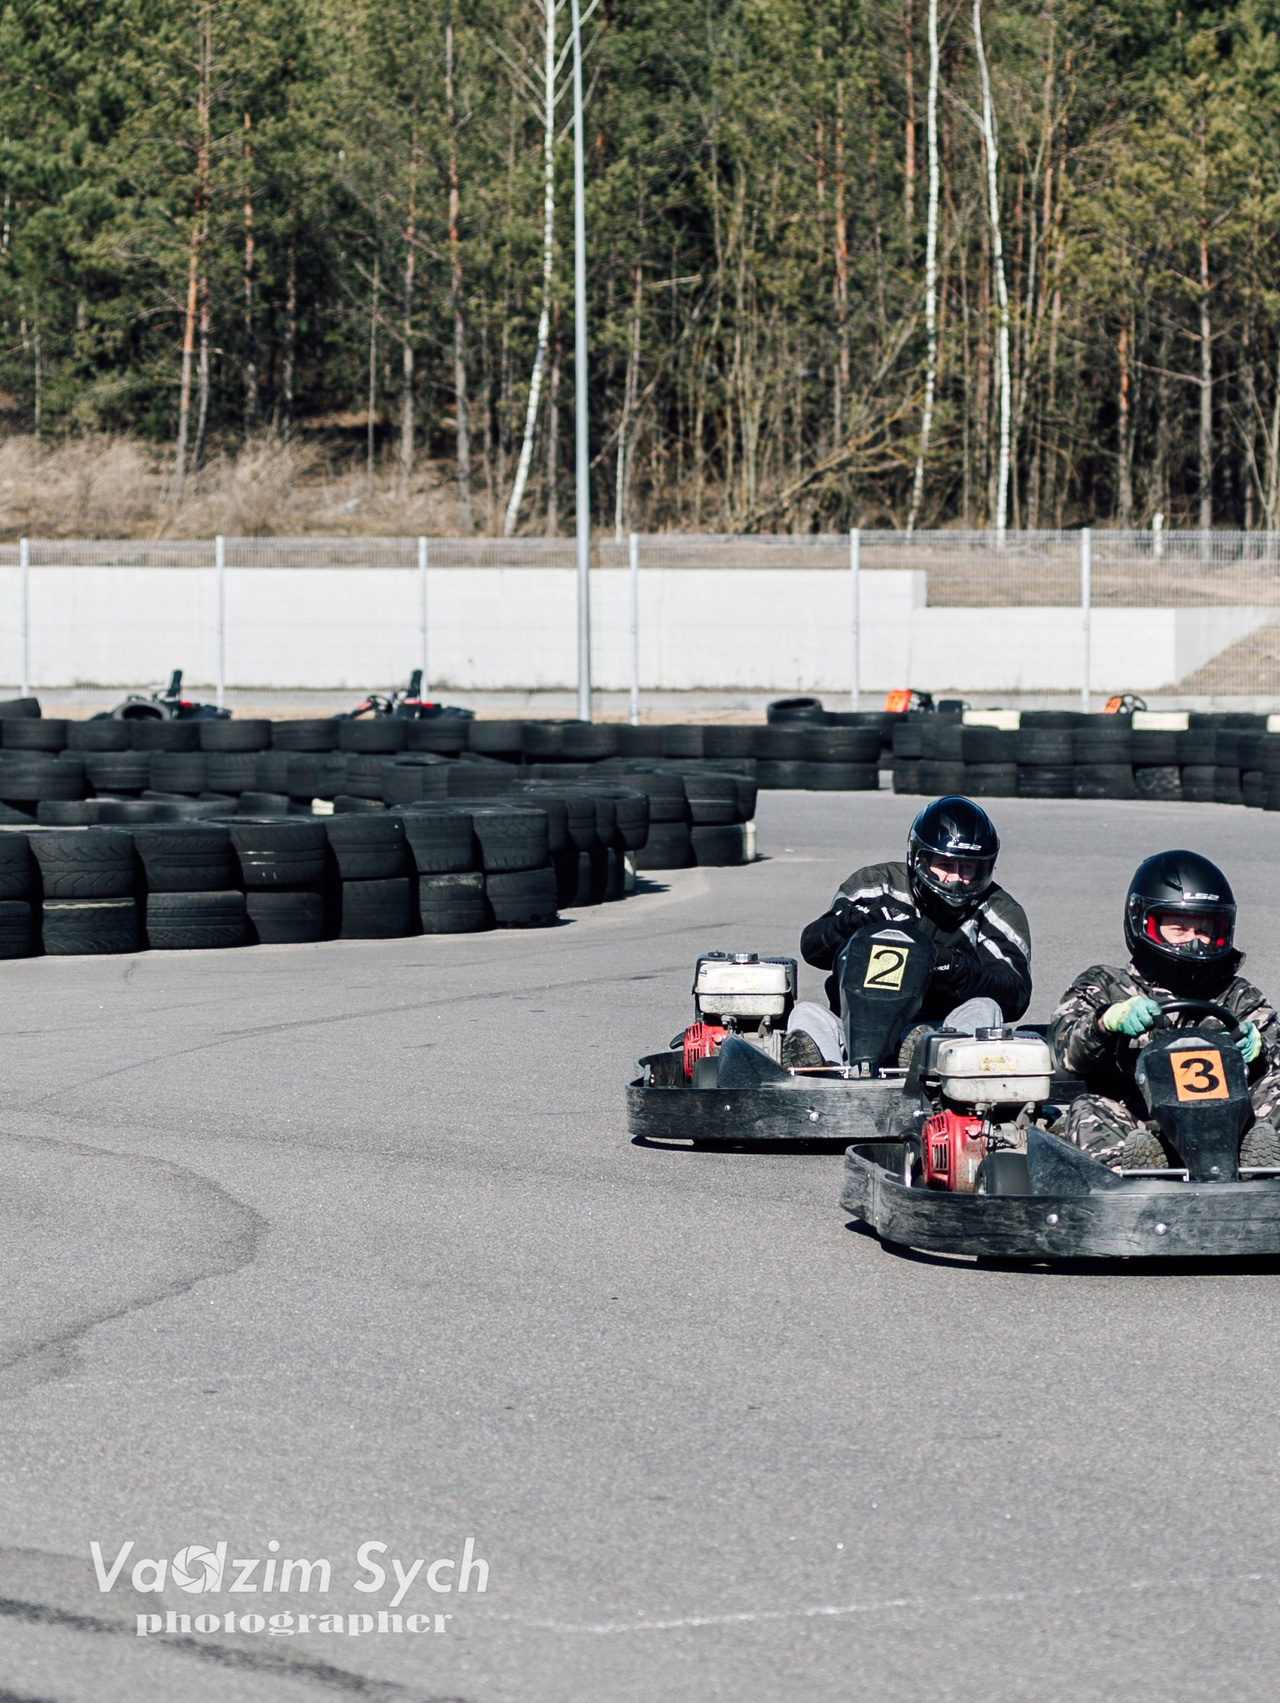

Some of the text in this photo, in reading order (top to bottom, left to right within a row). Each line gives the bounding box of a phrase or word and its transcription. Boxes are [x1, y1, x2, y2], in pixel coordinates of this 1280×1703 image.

[946, 841, 982, 851] LS2
[1183, 892, 1220, 901] LS2
[866, 949, 905, 988] 2
[1180, 1057, 1220, 1094] 3
